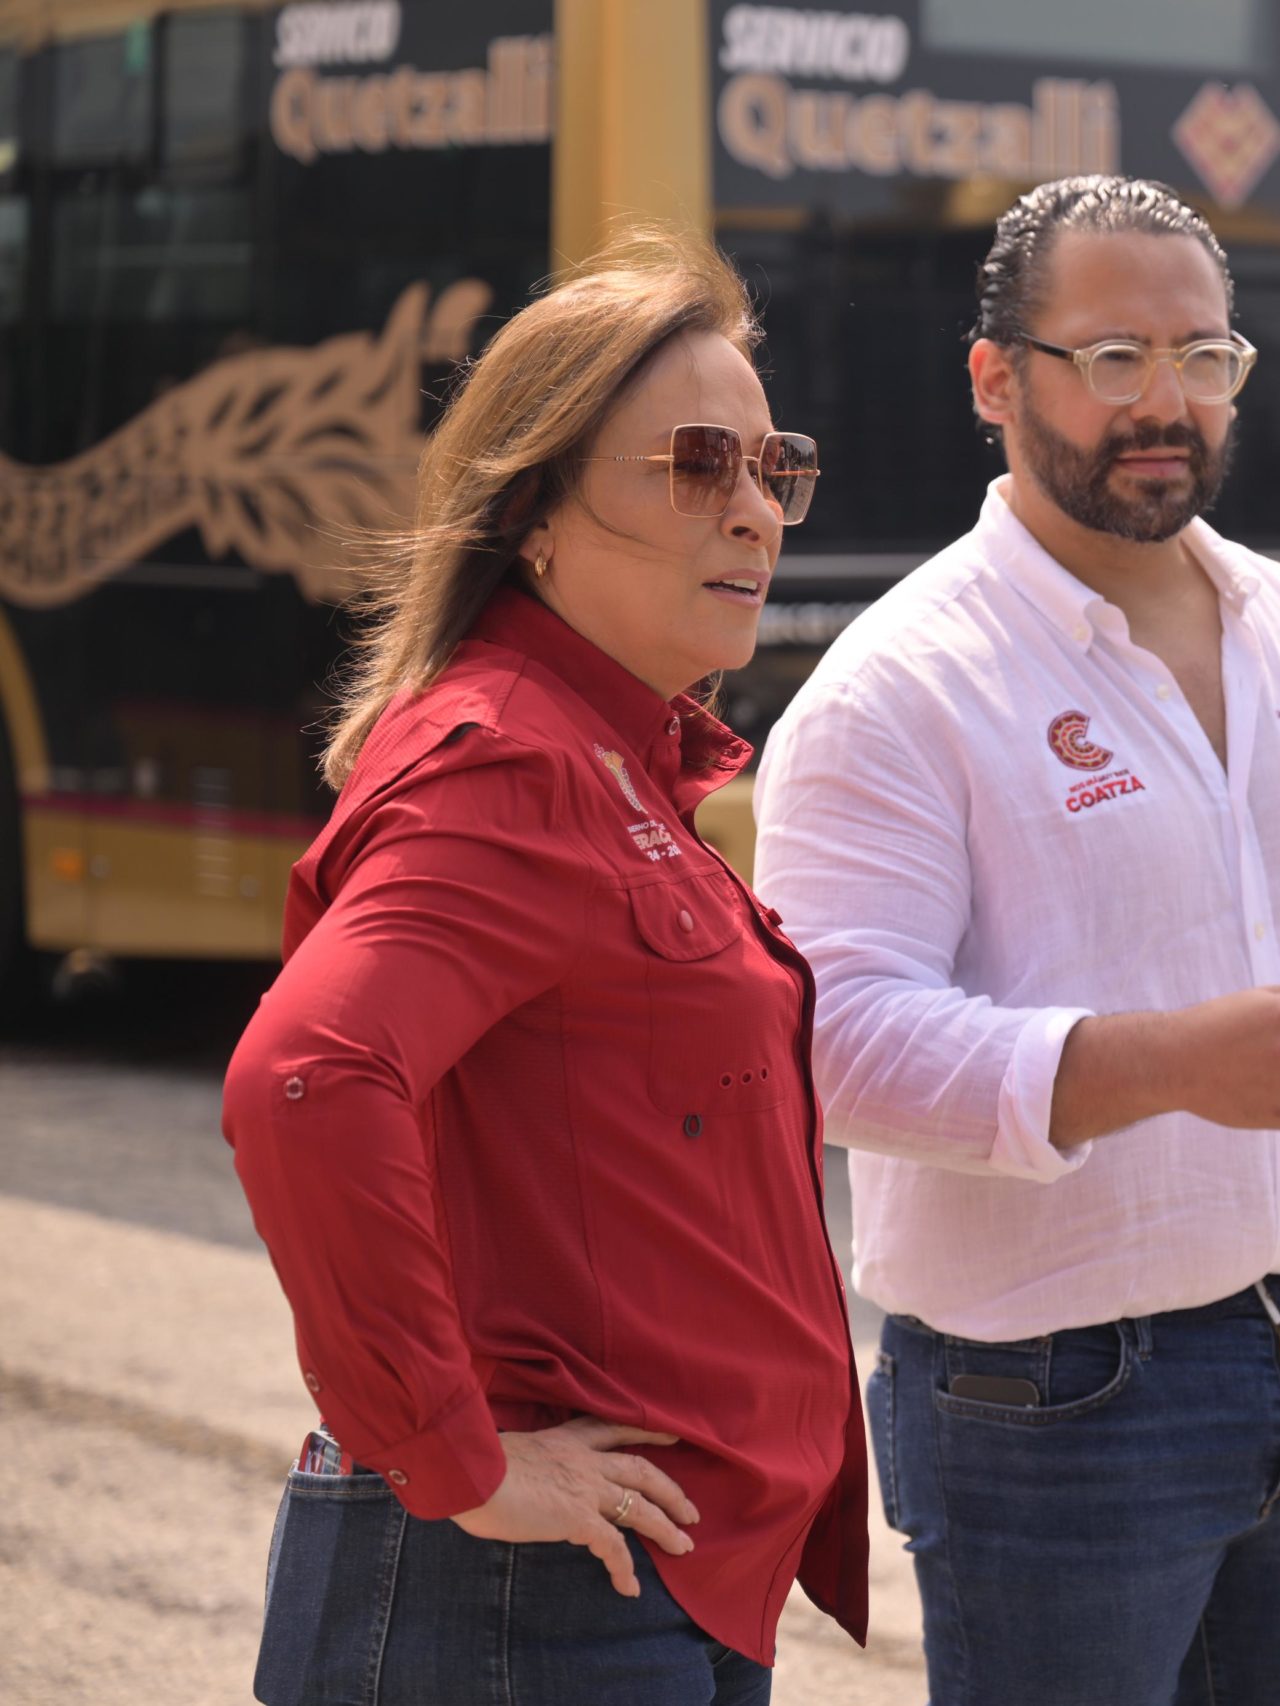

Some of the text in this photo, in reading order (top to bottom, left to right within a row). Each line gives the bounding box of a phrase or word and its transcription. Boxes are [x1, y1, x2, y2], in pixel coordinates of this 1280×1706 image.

[270, 35, 553, 163] Quetzalli
[719, 72, 1118, 180] Quetzalli
[1066, 775, 1145, 812] COATZA
